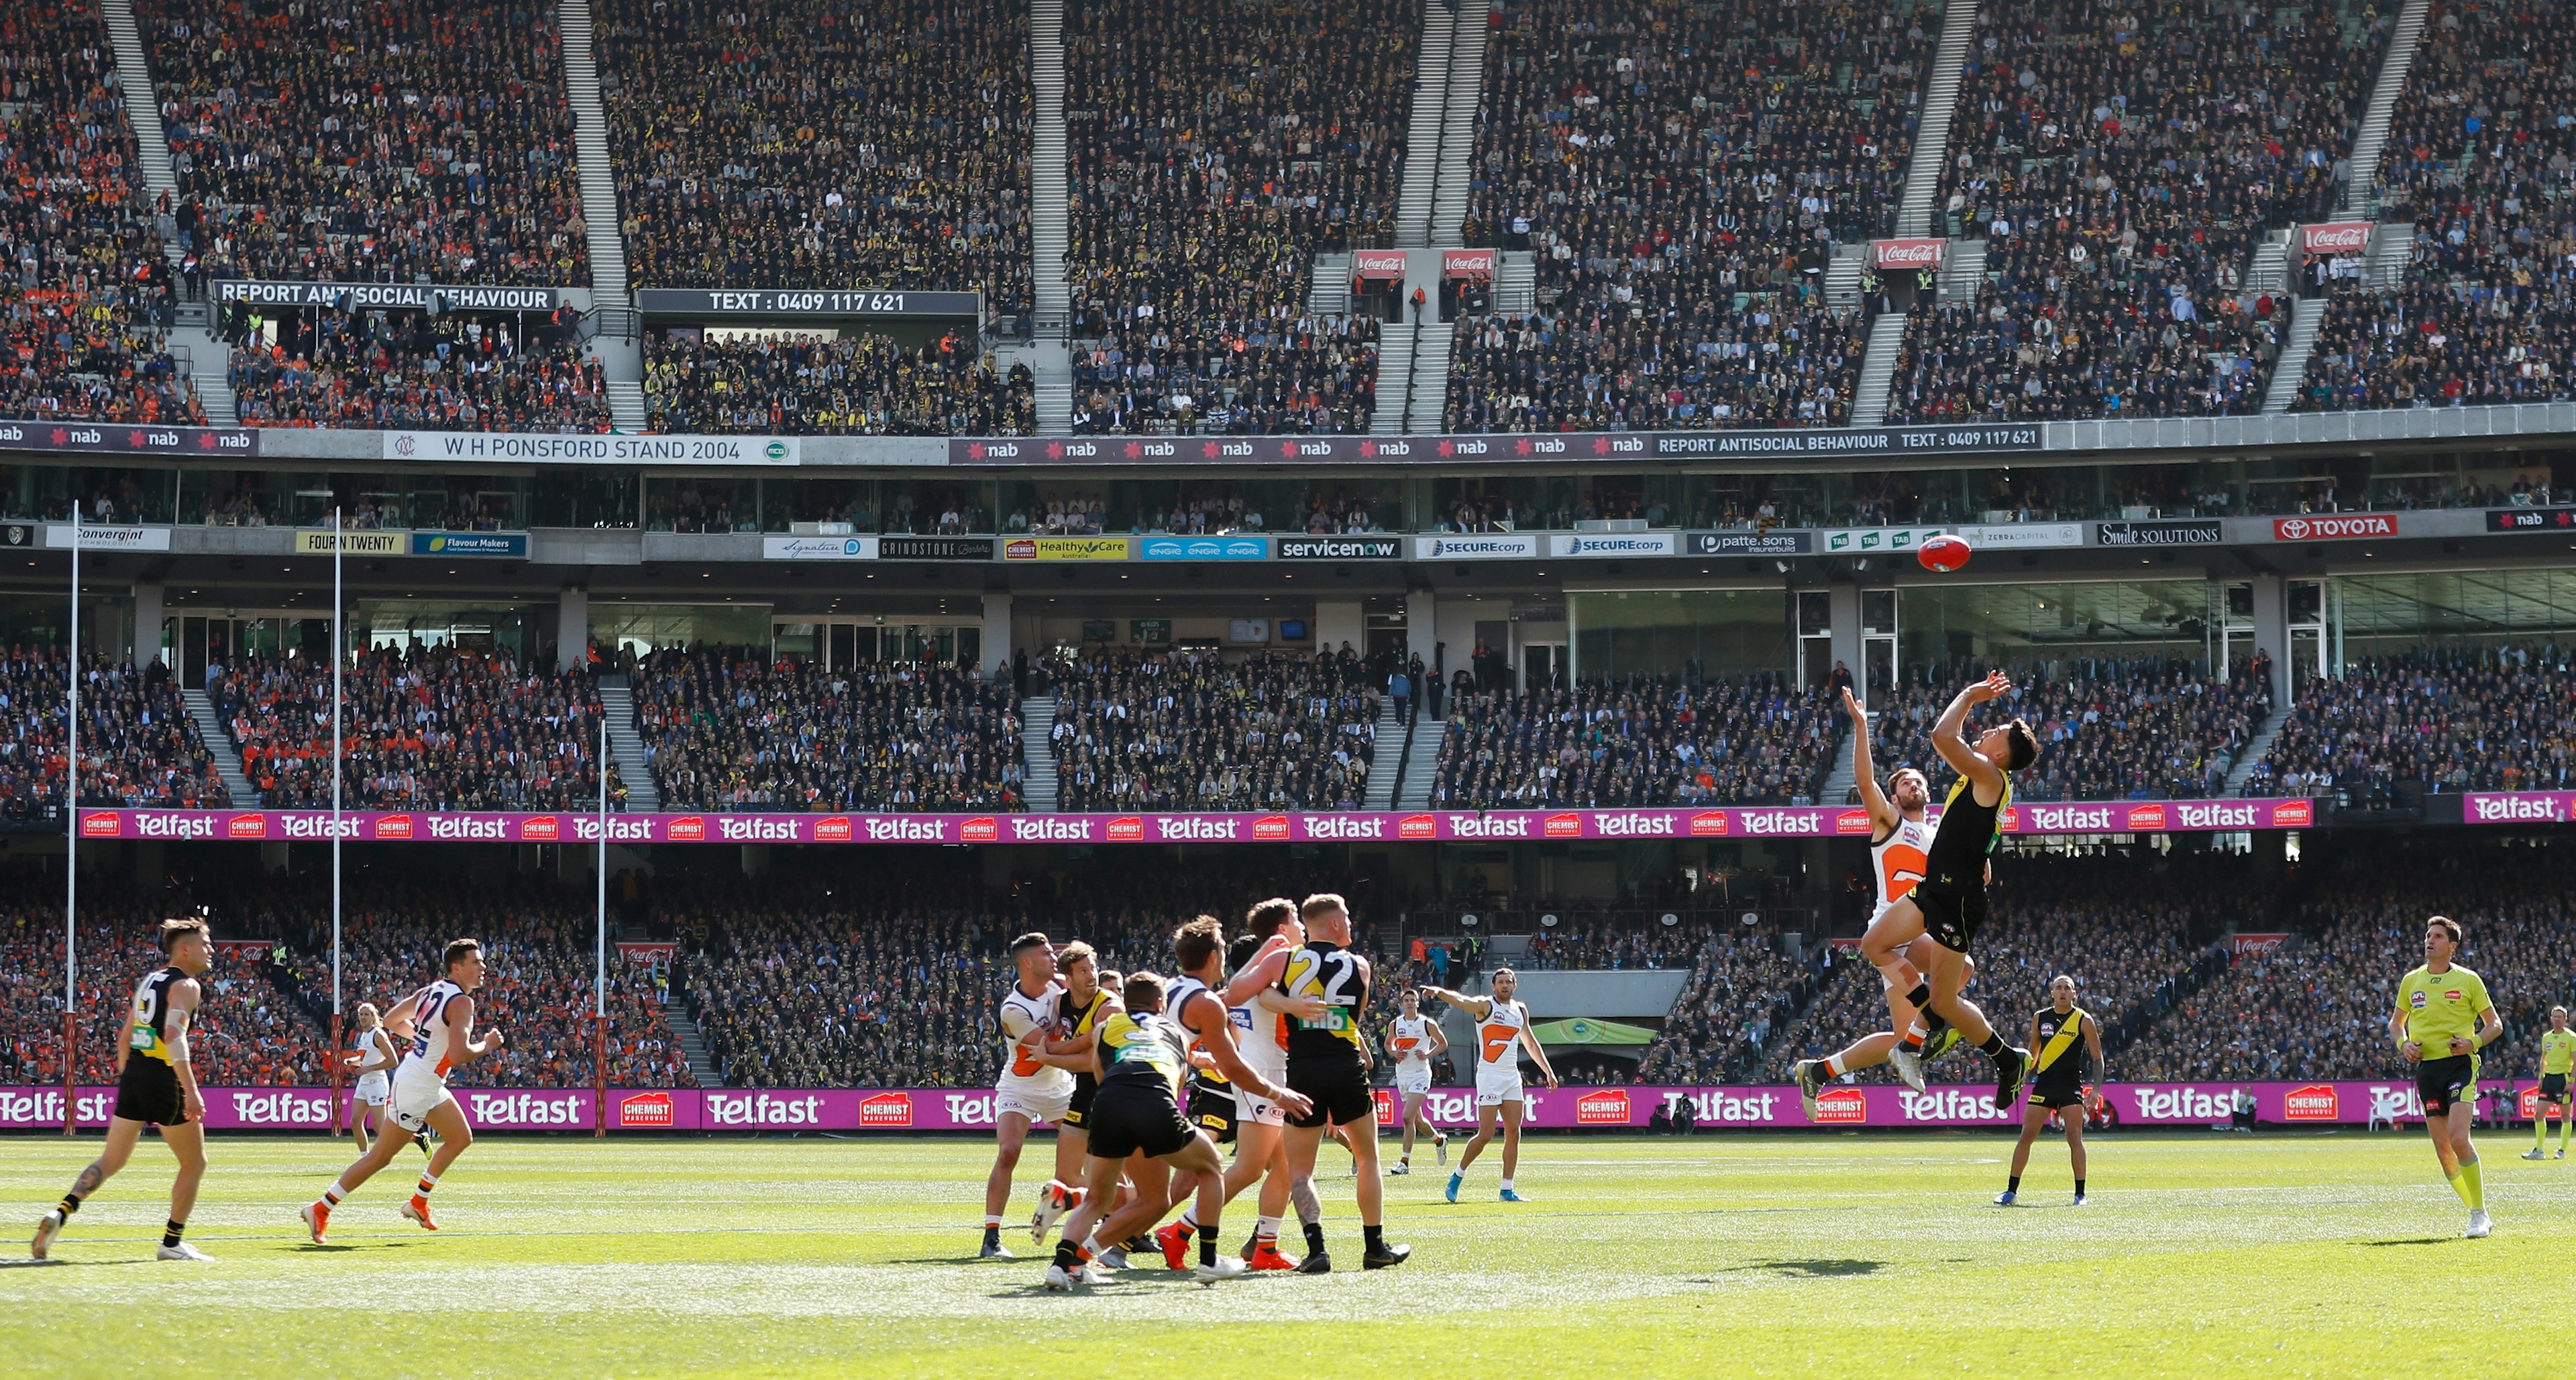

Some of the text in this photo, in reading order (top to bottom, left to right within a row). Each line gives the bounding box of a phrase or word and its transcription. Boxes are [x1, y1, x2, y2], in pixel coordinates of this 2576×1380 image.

[2314, 229, 2363, 247] Coca-Cola
[1886, 245, 1935, 262] Coca-Cola
[1364, 258, 1399, 270] Coca-Cola
[1452, 257, 1487, 270] Coca-Cola
[222, 284, 303, 303] REPORT
[709, 293, 761, 309] TEXT
[777, 293, 824, 310] 0409
[831, 294, 867, 311] 117
[871, 295, 904, 311] 621
[0, 427, 23, 441] ab
[71, 429, 101, 443] nab
[148, 431, 178, 445] nab
[219, 433, 250, 448] nab
[1659, 438, 1716, 452] REPORT
[1719, 437, 1805, 451] ANTISOCIAL
[1808, 435, 1888, 450] BEHAVIOUR
[1901, 434, 1936, 447] TEXT
[1948, 433, 1980, 446] 0409
[1985, 432, 2009, 445] 117
[2012, 431, 2036, 444] 621
[445, 439, 740, 460] W H PONSFORD STAND 2004
[987, 443, 1018, 458] nab
[1066, 443, 1096, 458] nab
[1144, 443, 1175, 457] nab
[1222, 442, 1252, 456] nab
[1301, 441, 1332, 456] nab
[1379, 441, 1409, 456] nab
[1457, 440, 1487, 454] nab
[1535, 439, 1566, 454] nab
[1613, 437, 1643, 452] nab
[2312, 519, 2390, 535] TOYOTA
[2517, 515, 2542, 527] nab
[2103, 524, 2218, 544] Smile SOLUTIONS
[309, 535, 335, 549] FOUR
[350, 536, 394, 550] TWENTY
[480, 539, 508, 547] Makers
[882, 543, 955, 555] GRINDSTONE
[1041, 542, 1124, 553] Healthy Care
[1283, 540, 1395, 557] servicenow
[1446, 542, 1525, 553] SECUREcorp
[1584, 541, 1663, 551] SECUREcorp
[2178, 804, 2258, 827] Telfast
[2275, 810, 2308, 818] CHEMIST
[2475, 797, 2556, 819] Telfast
[1595, 814, 1676, 835] Telfast
[1693, 819, 1725, 827] CHEMIST
[1741, 812, 1821, 833] Telfast
[2031, 808, 2112, 829] Telfast
[2131, 813, 2163, 821] CHEMIST
[136, 814, 213, 838] Telfast
[231, 822, 262, 830] CHEMIST
[428, 816, 508, 837] Telfast
[574, 814, 653, 841] Tefast
[720, 818, 800, 839] Telfast
[866, 818, 946, 839] Telfast
[963, 825, 994, 833] CHEMIST
[1012, 818, 1091, 839] Telfast
[1158, 818, 1238, 839] Telfast
[1256, 824, 1287, 832] CHEMIST
[1304, 816, 1385, 838] Telfast
[1402, 822, 1433, 831] CHEMIST
[1450, 815, 1529, 837] Telfast
[1547, 821, 1578, 829] CHEMIST
[1289, 949, 1357, 1005] 22
[2059, 1029, 2076, 1037] Jeep
[470, 1094, 580, 1124] Telfast
[625, 1104, 669, 1114] CHEMIST
[708, 1094, 818, 1124] Telfast
[863, 1104, 908, 1114] CHEMIST
[1581, 1102, 1626, 1112] CHEMIST
[2288, 1097, 2333, 1108] CHEMIST
